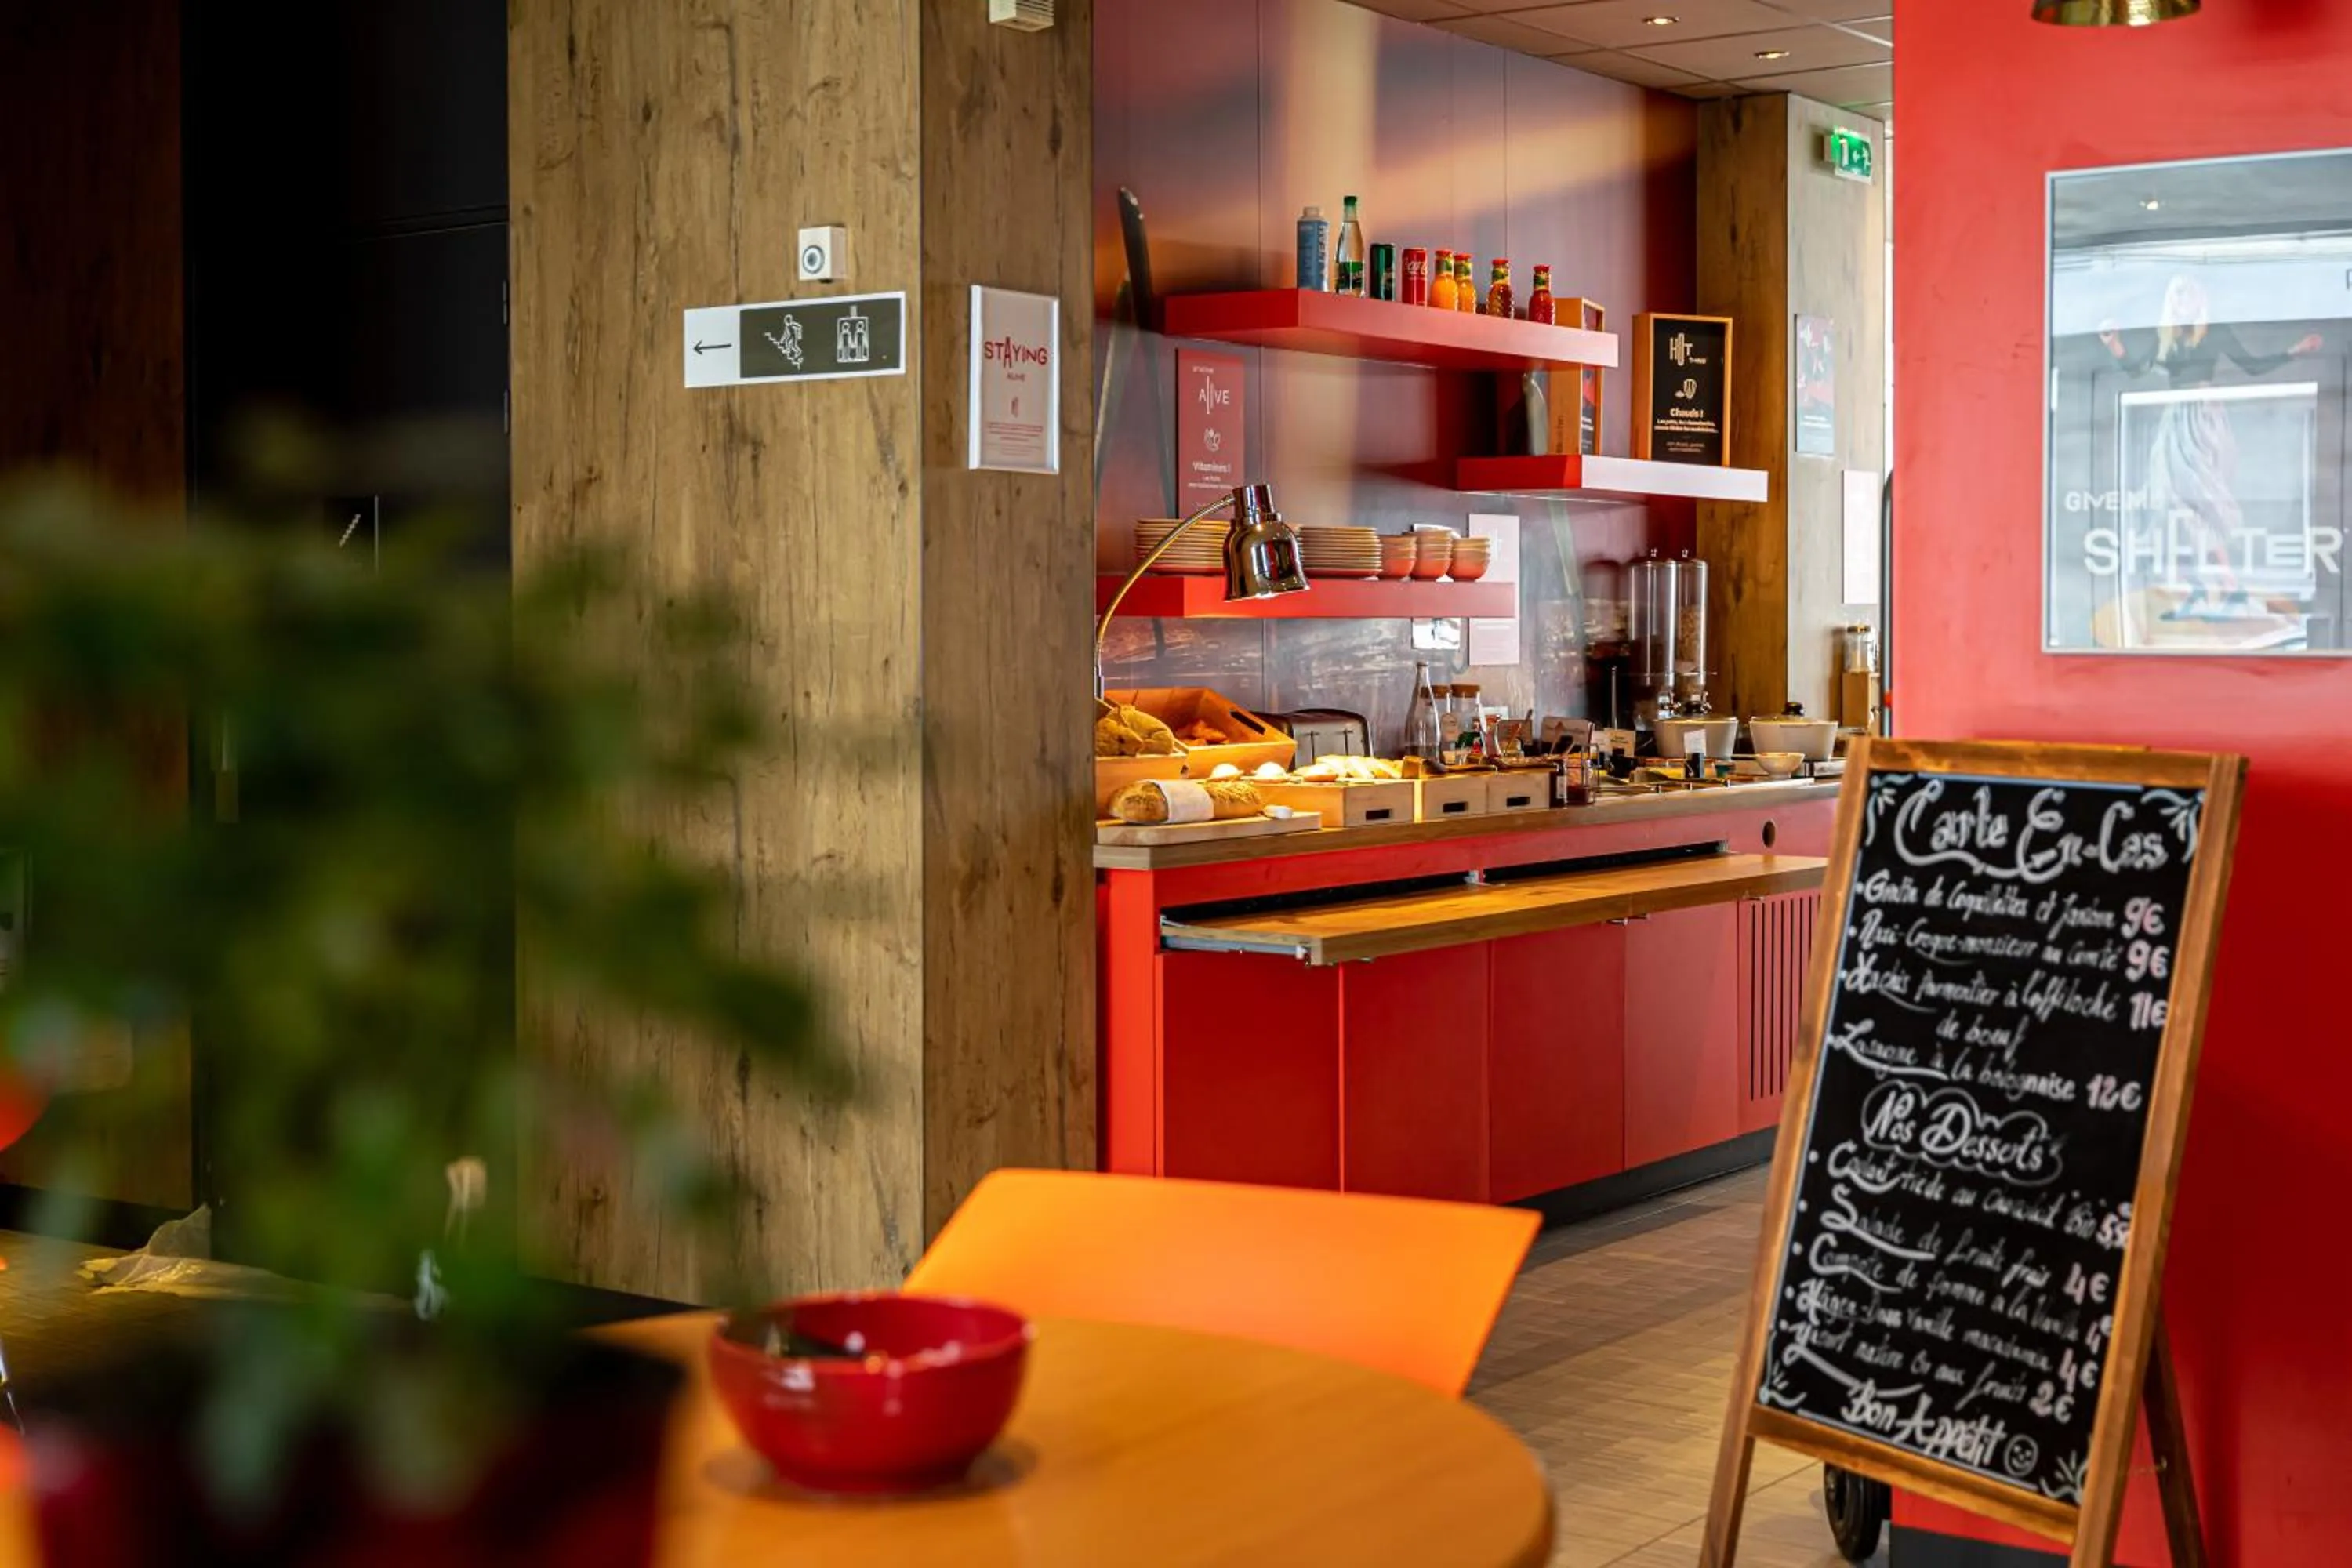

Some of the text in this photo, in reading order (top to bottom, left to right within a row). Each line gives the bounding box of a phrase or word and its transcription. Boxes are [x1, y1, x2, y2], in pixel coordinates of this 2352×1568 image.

[984, 336, 1048, 368] STAYING
[2082, 509, 2343, 592] SHELTER
[1894, 779, 2009, 867] Carte
[2120, 896, 2165, 939] 9€
[2124, 939, 2170, 982] 9€
[1936, 1008, 1960, 1040] de
[2085, 1073, 2143, 1112] 12€
[1920, 1102, 2043, 1171] Desserts
[2063, 1261, 2111, 1306] 4€
[2057, 1347, 2099, 1394] 4€
[1839, 1377, 1898, 1432] Bon
[2027, 1379, 2075, 1425] 2€
